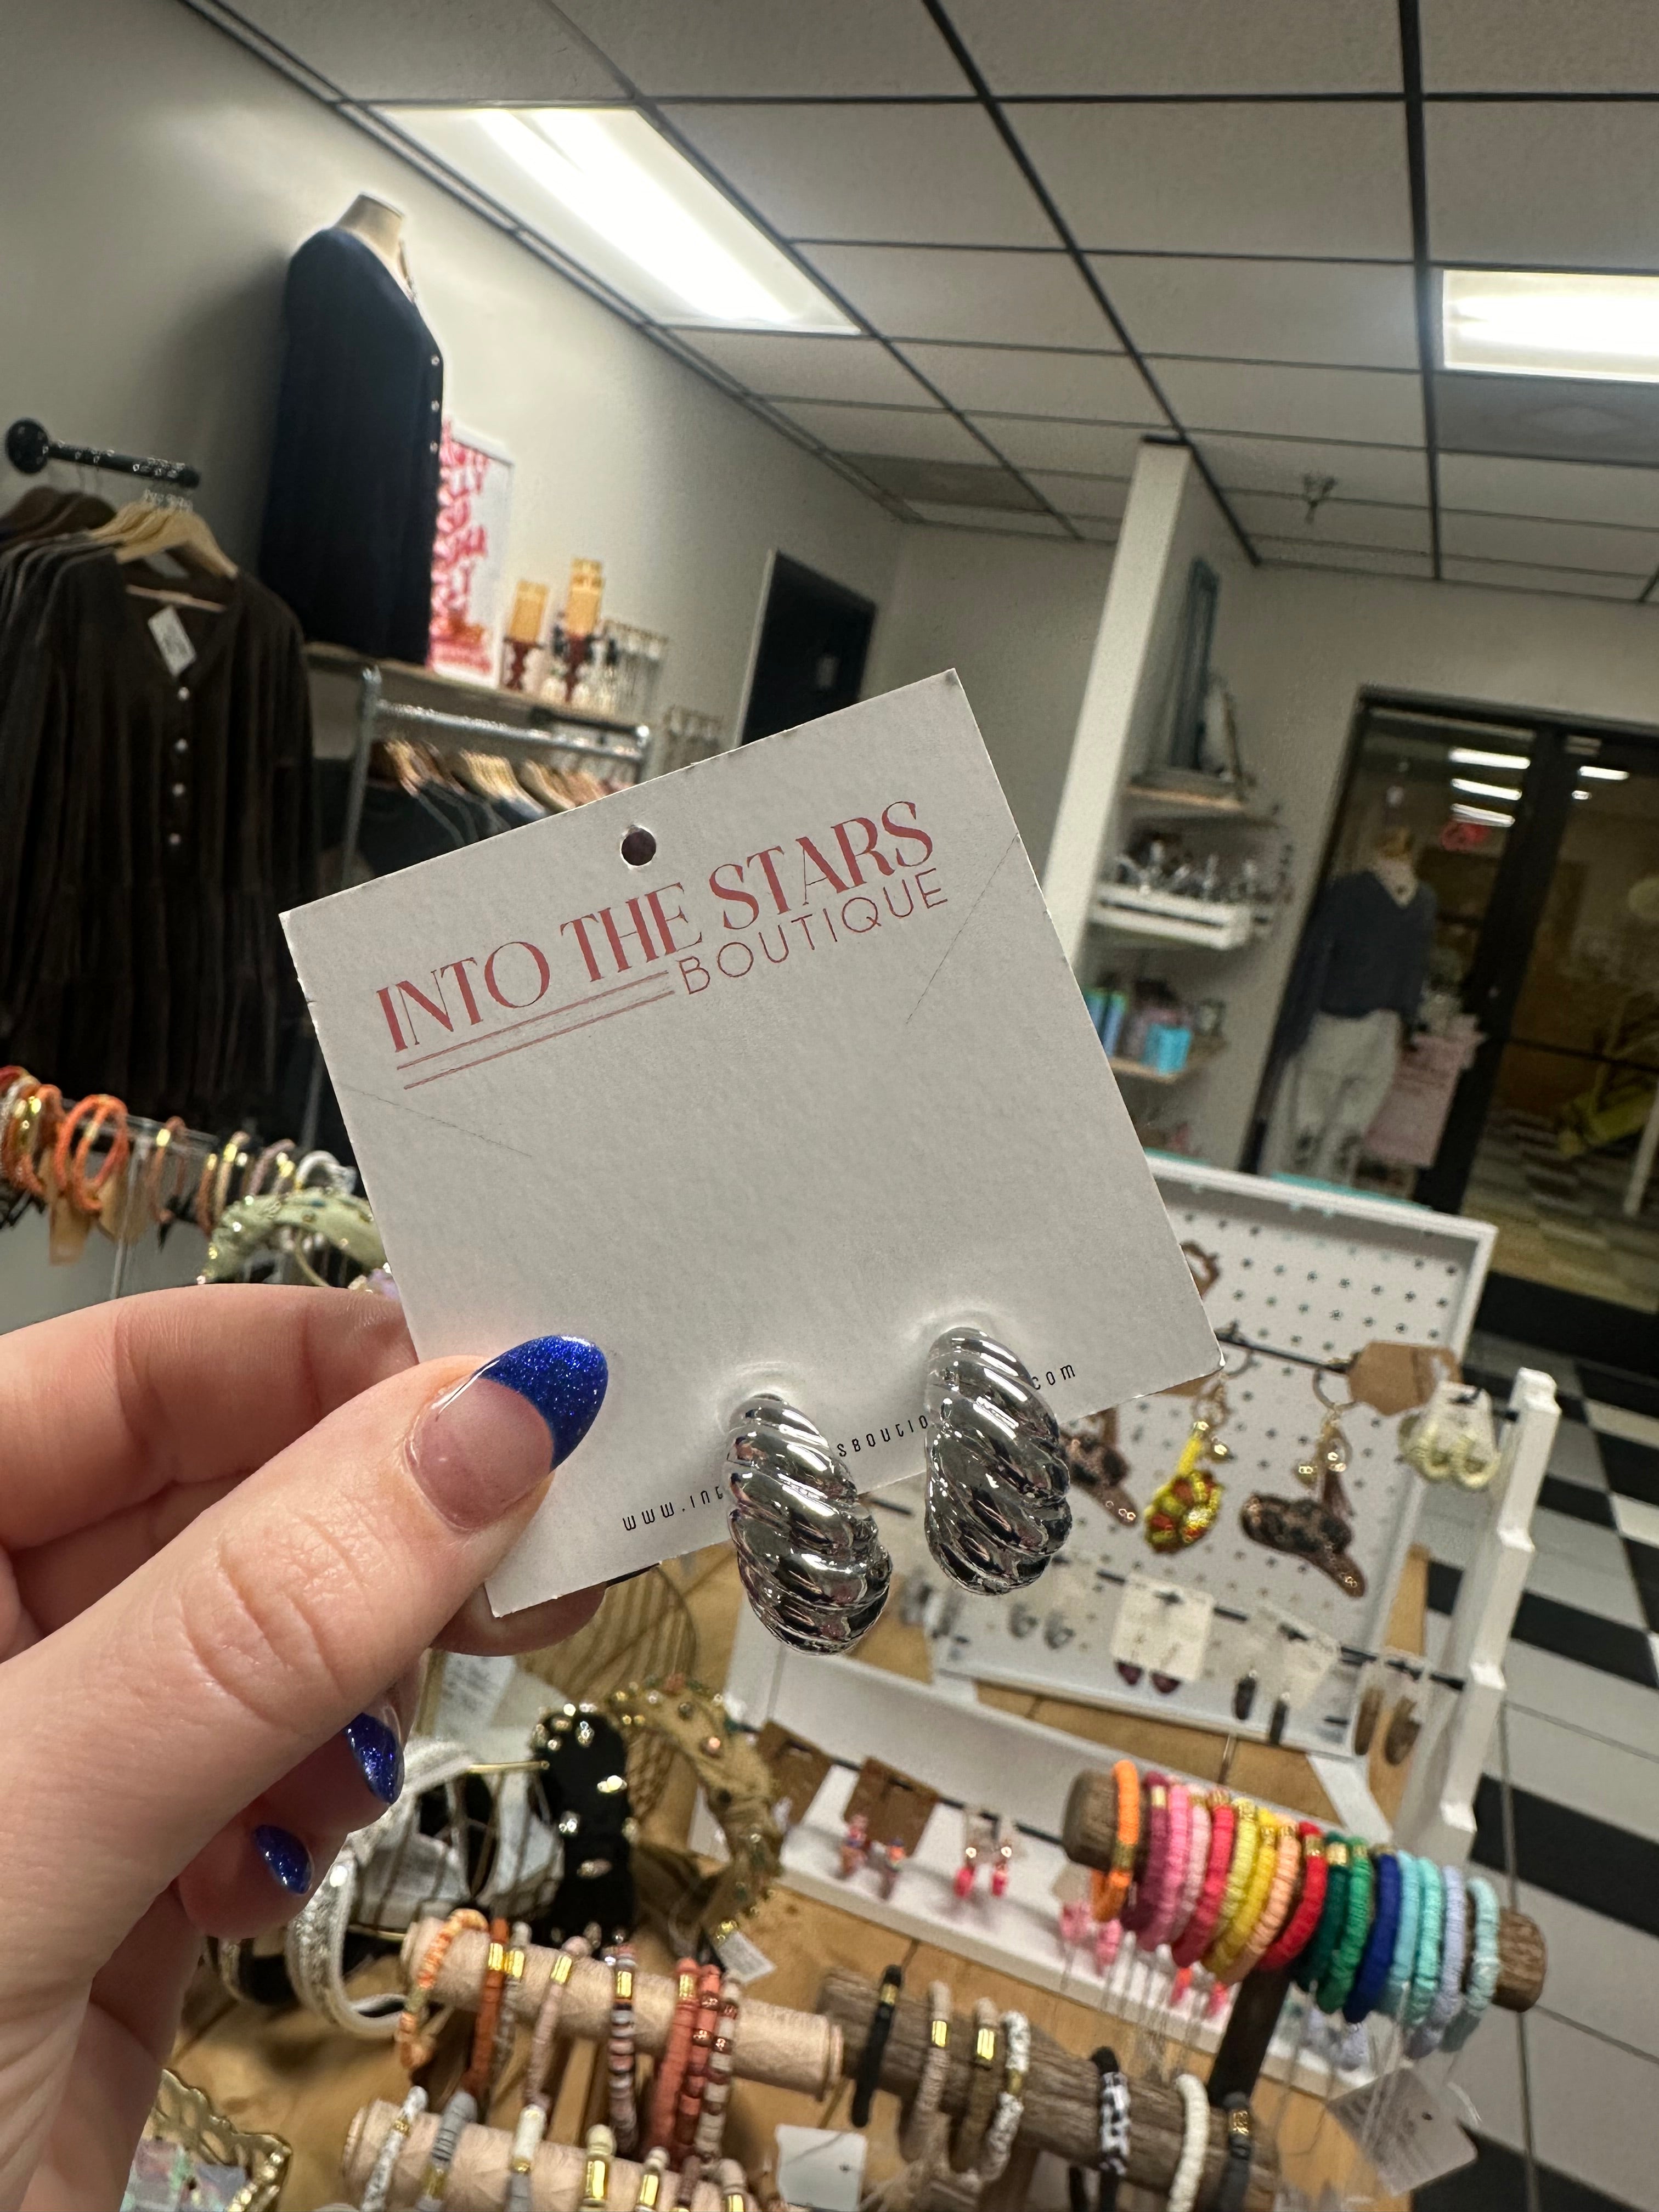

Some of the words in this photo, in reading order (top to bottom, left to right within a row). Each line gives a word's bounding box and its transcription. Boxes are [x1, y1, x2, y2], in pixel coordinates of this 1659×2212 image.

[377, 941, 551, 1053] INTO
[560, 882, 702, 982] THE
[709, 801, 933, 930] STARS
[677, 868, 947, 995] BOUTIQUE
